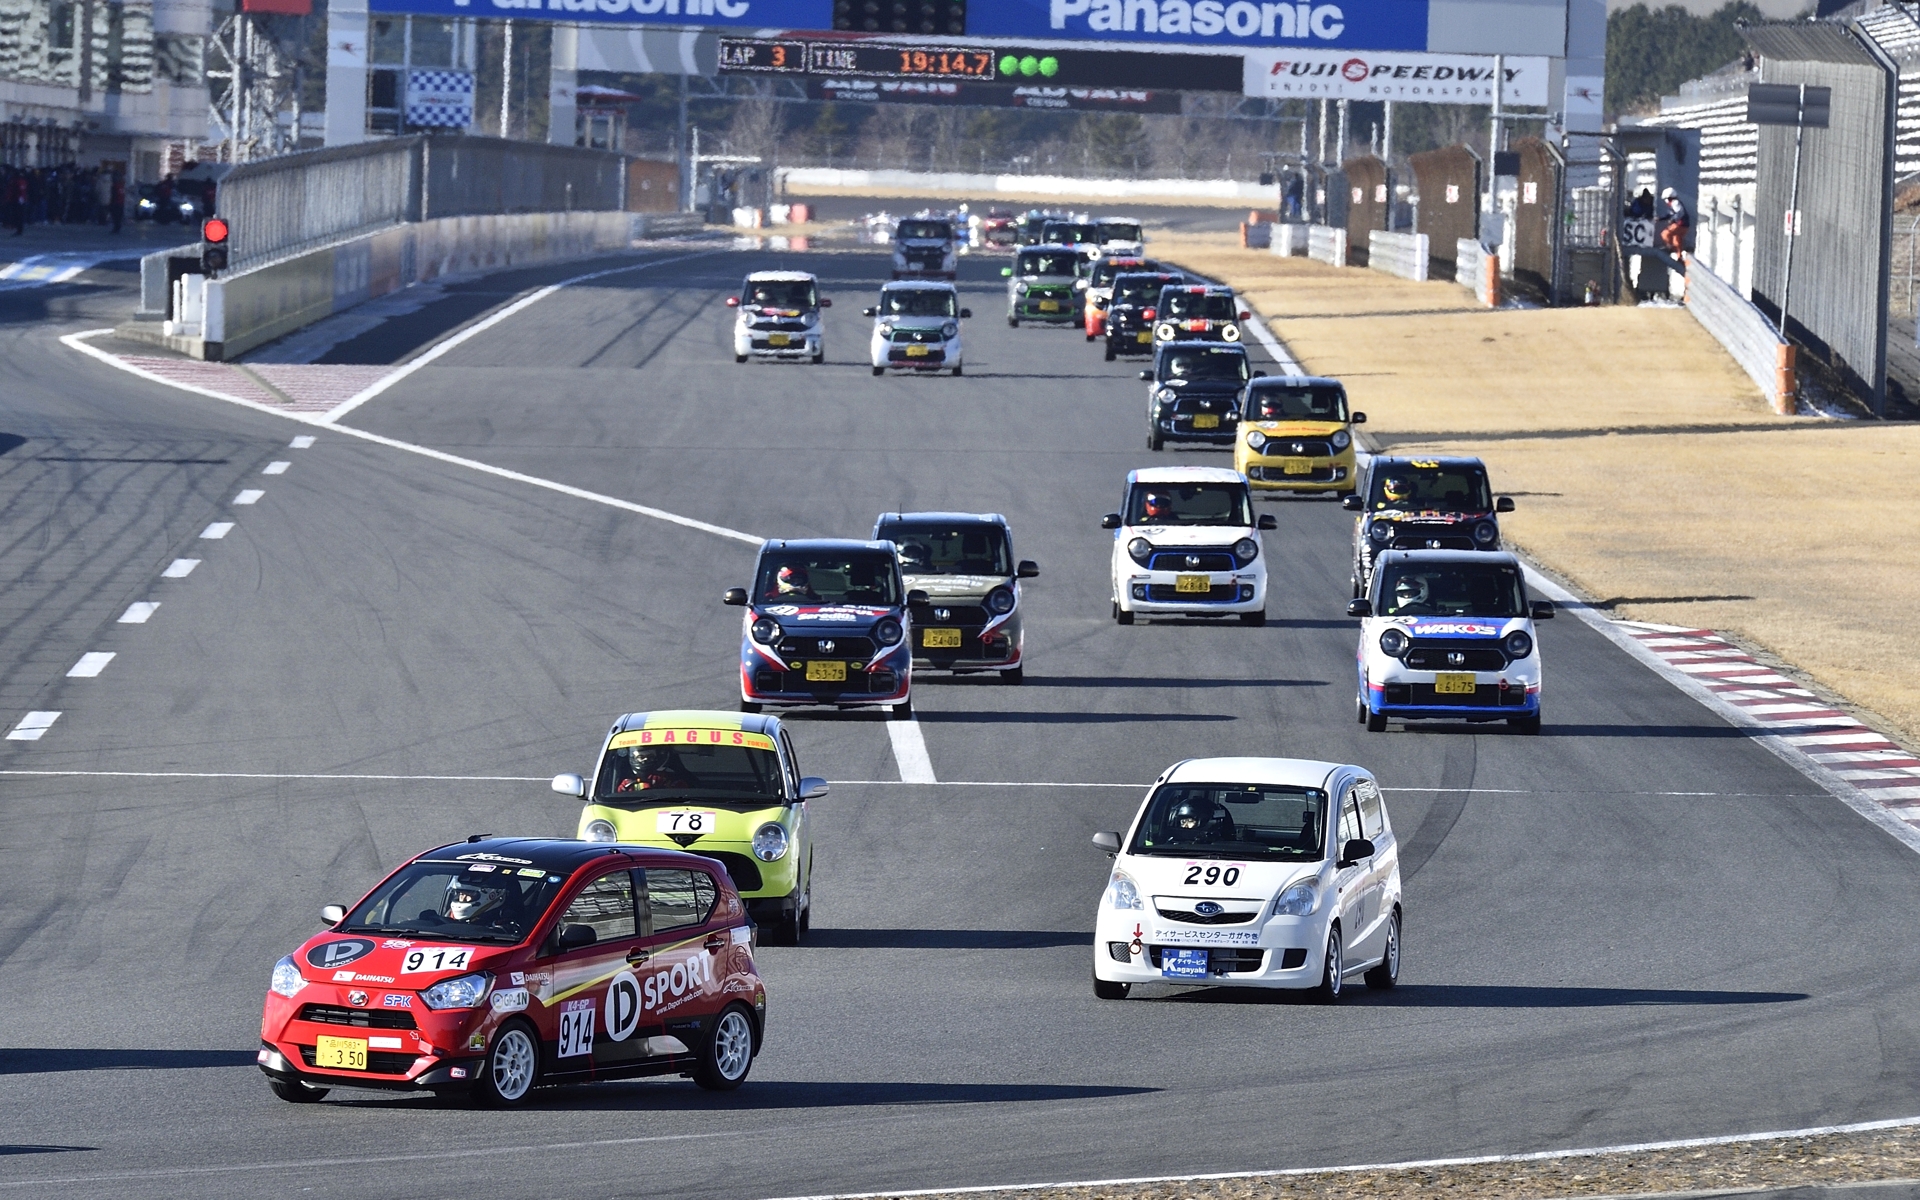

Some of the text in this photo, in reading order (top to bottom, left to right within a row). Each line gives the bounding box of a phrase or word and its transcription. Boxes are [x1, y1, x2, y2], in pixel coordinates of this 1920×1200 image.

[1050, 0, 1344, 40] Panasonic
[721, 46, 786, 67] LAP 3
[815, 50, 989, 74] TIME 19:14.7
[1270, 60, 1338, 78] FUJI
[1368, 85, 1522, 98] MOTORSPORS
[1623, 224, 1645, 243] SC
[932, 637, 959, 646] 54-00
[815, 669, 844, 680] 53-79
[1445, 682, 1473, 692] 61-75
[641, 730, 744, 745] BAGUS
[746, 740, 769, 748] TOKYO
[670, 813, 702, 831] 78
[1183, 865, 1240, 887] 290
[406, 951, 467, 971] 914
[355, 973, 395, 983] DAIHATSU
[525, 972, 551, 982] DAIHATSU
[644, 949, 710, 1010] SPORT
[383, 994, 413, 1007] SPK
[503, 991, 528, 1008] GP-1N
[567, 999, 589, 1011] K4-GP
[560, 1010, 592, 1055] 914
